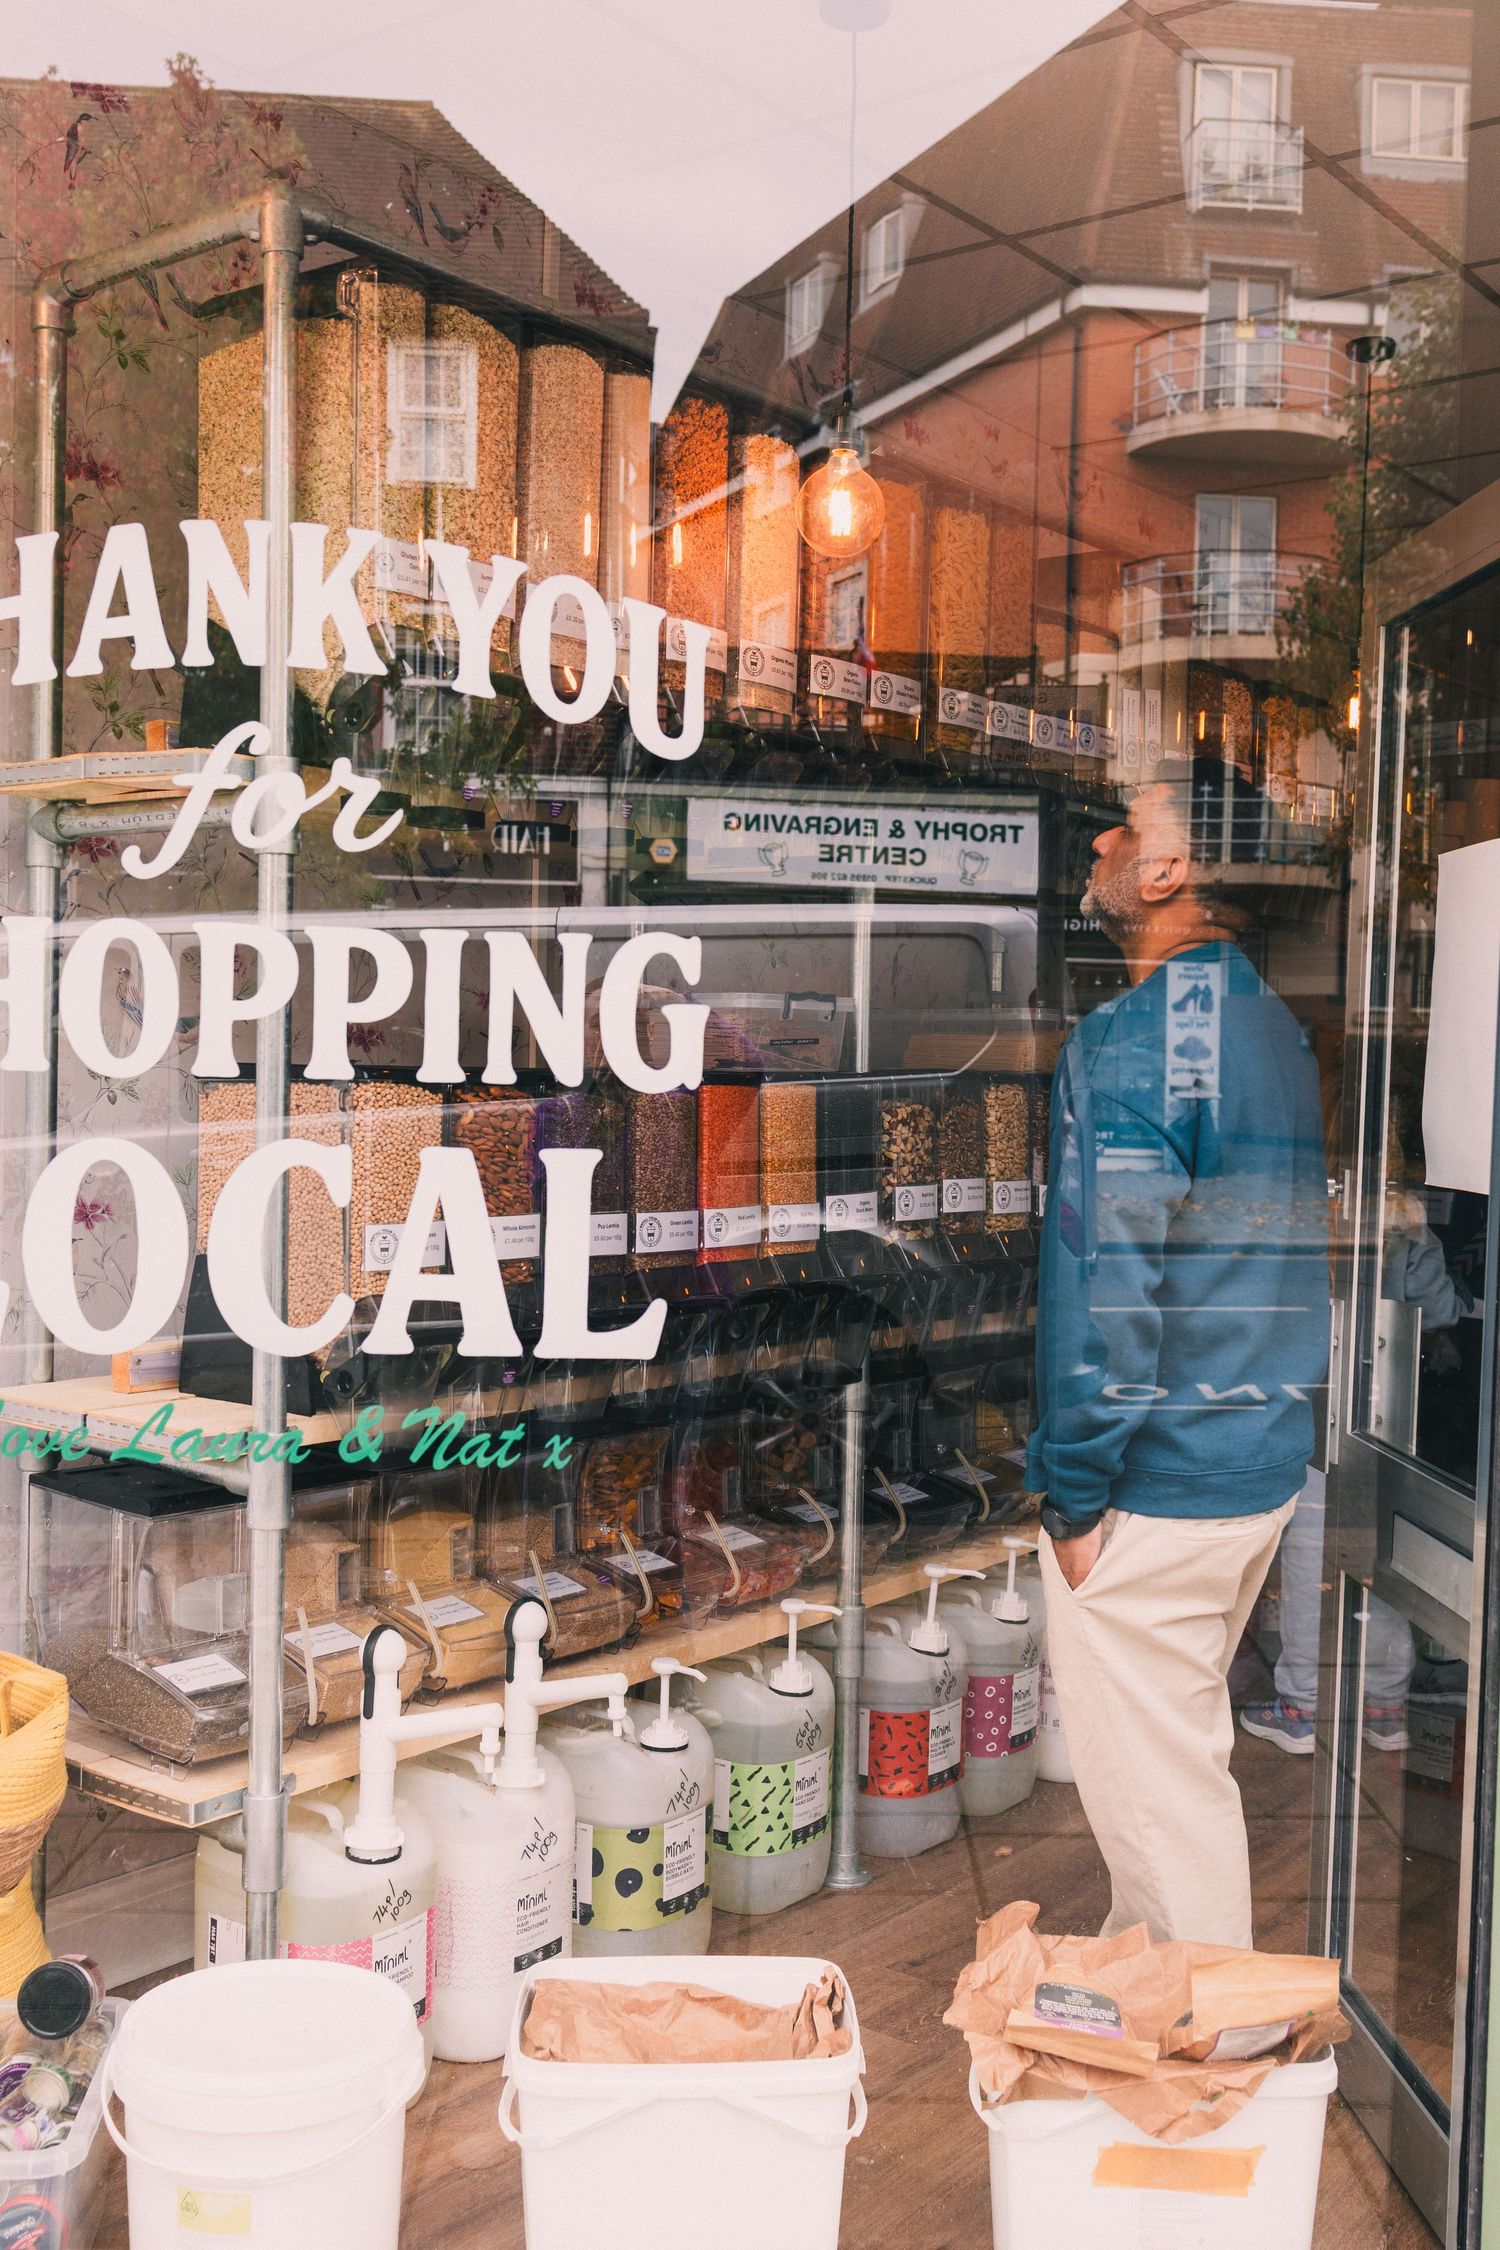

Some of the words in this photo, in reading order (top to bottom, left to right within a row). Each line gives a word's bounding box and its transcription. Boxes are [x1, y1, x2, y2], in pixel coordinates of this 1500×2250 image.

[423, 539, 712, 761] YOU
[122, 721, 404, 880] for
[121, 812, 176, 824] EDIUM
[0, 1137, 668, 1360] OCAL
[0, 1400, 90, 1461] ove
[111, 1402, 312, 1466] Laura
[338, 1404, 385, 1464] &
[402, 1406, 524, 1470] Nat
[542, 1435, 573, 1470] x
[665, 1853, 696, 1870] ECO-FRIENDLY
[665, 1869, 683, 1882] BUBBLE
[683, 1865, 694, 1874] BATH
[516, 1904, 552, 1923] ECO-FRIENDLY
[516, 1920, 530, 1930] HAIR
[516, 1918, 549, 1936] CONDITIONER
